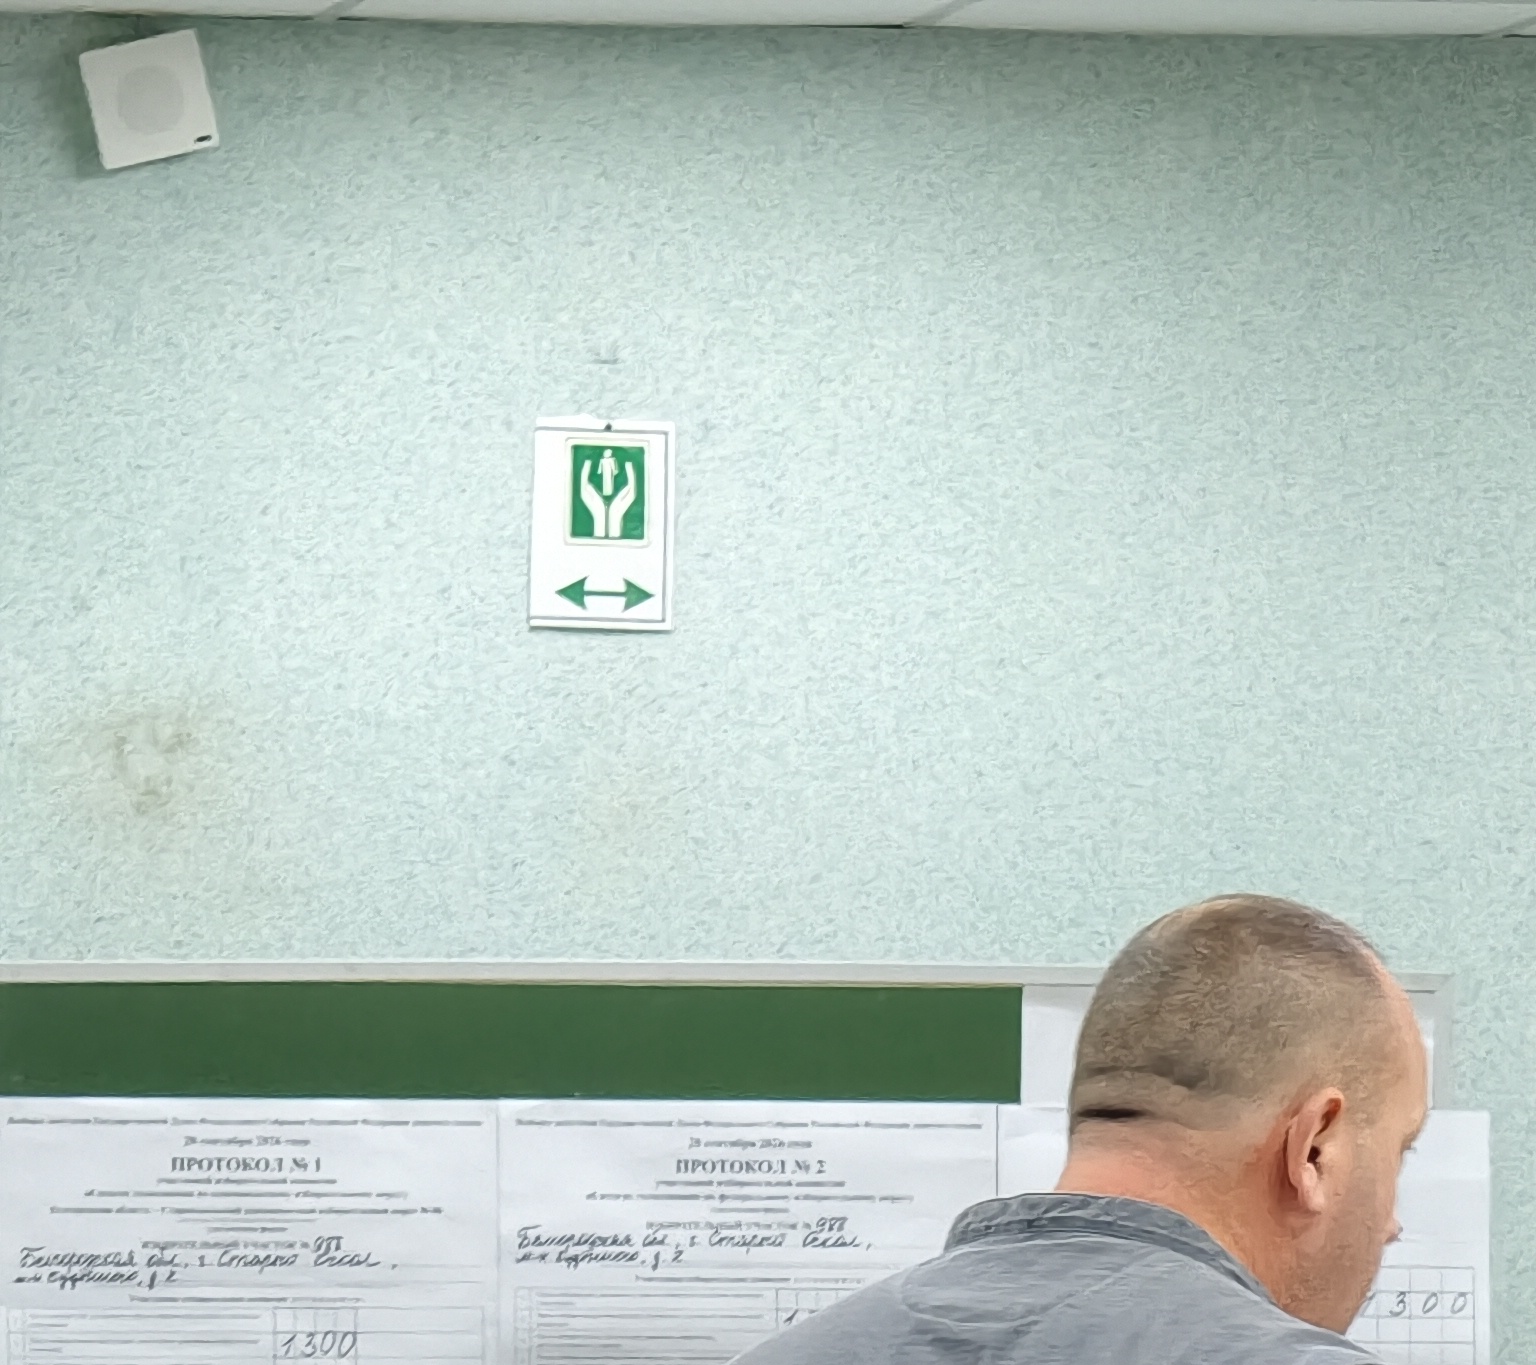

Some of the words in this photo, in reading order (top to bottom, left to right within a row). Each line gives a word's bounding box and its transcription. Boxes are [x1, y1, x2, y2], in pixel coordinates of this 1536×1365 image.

[171, 1157, 284, 1174] ПРОТОКОЛ
[315, 1156, 321, 1173] 1
[675, 1158, 787, 1175] ПРОТОКОЛ
[281, 1330, 358, 1360] 1300
